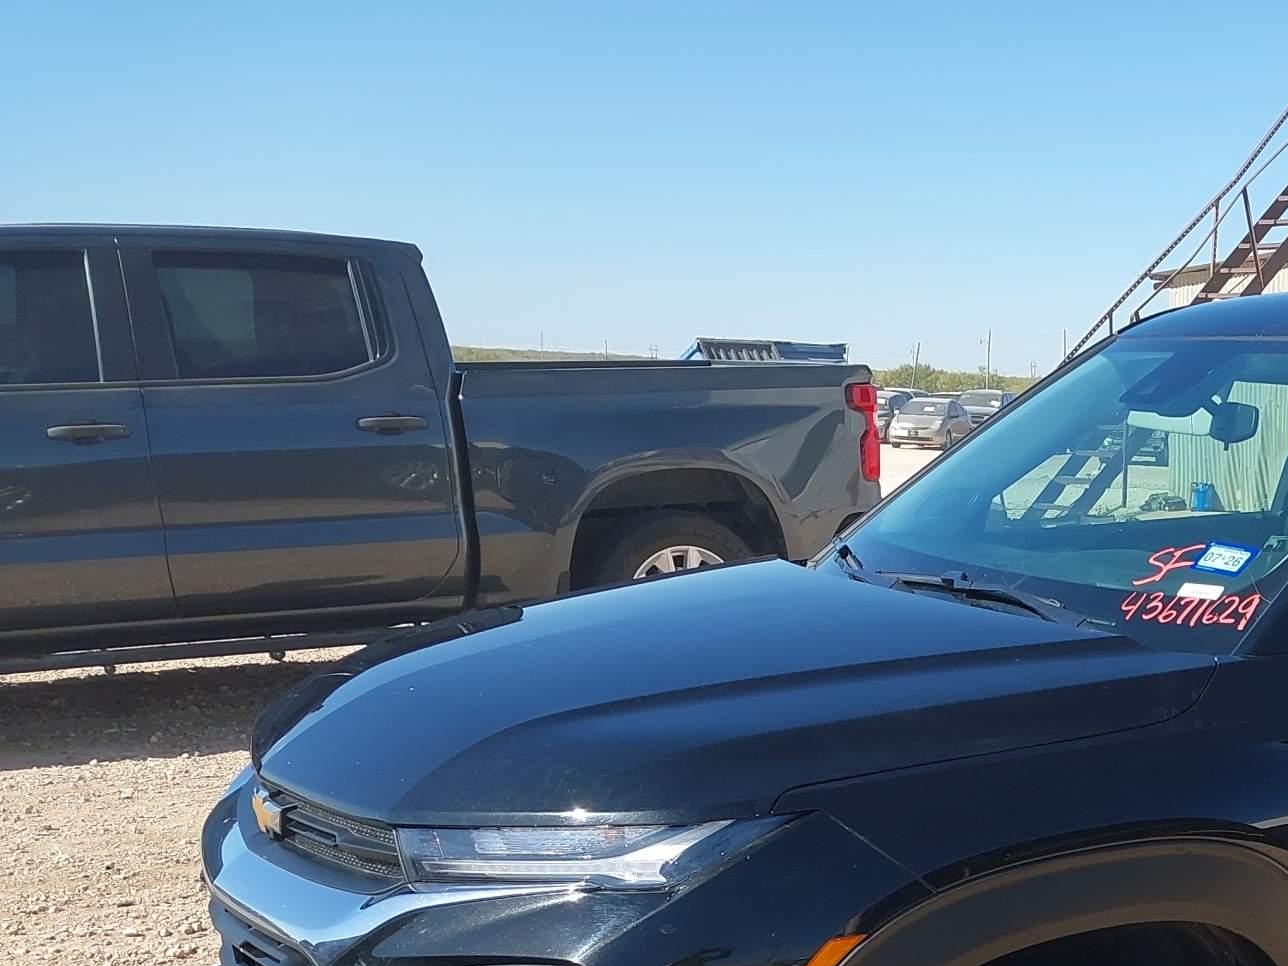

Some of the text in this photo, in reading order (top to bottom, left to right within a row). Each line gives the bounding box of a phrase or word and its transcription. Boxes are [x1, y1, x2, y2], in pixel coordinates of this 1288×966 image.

[1133, 544, 1206, 585] SF
[1203, 552, 1223, 563] 07
[1224, 556, 1243, 567] 26
[1121, 591, 1261, 631] 43671629
